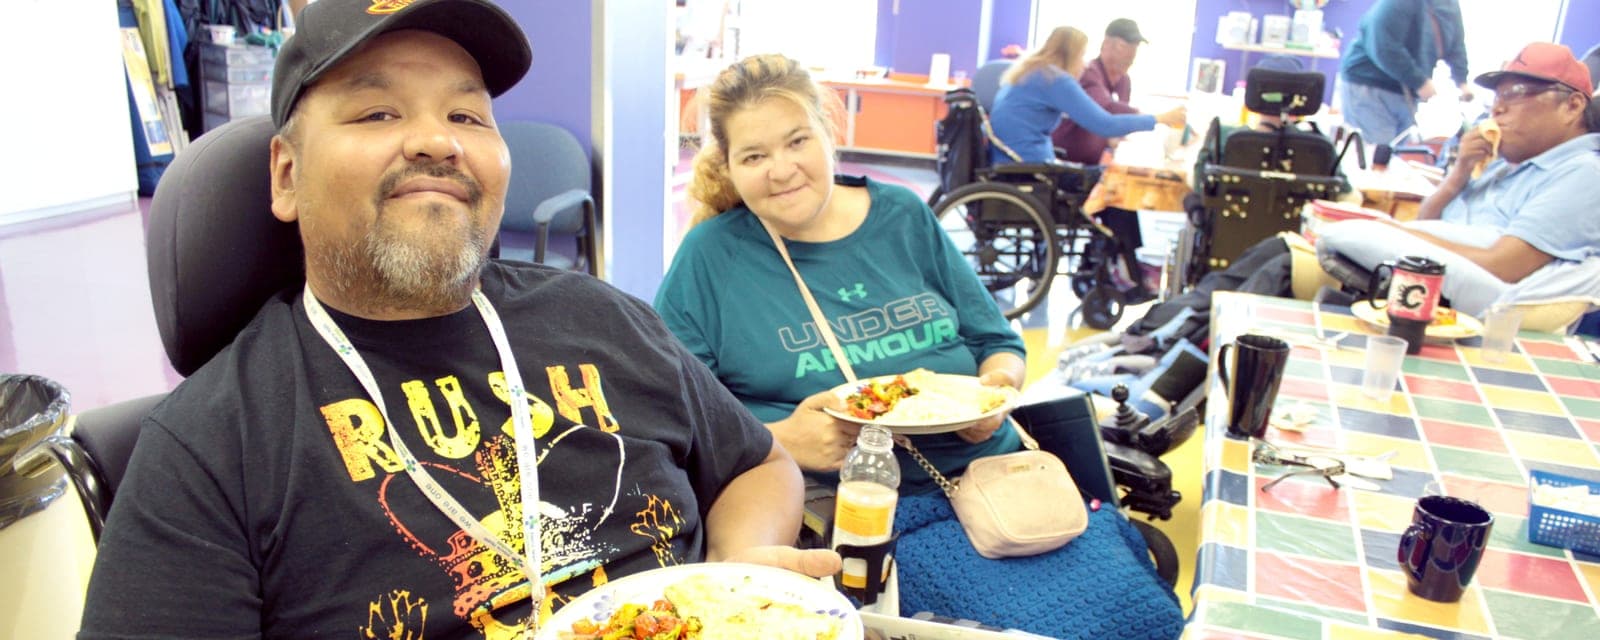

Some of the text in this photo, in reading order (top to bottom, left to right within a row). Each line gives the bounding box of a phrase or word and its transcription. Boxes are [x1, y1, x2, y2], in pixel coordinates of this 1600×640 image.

[319, 363, 621, 482] RUSH
[425, 482, 472, 529] we are one
